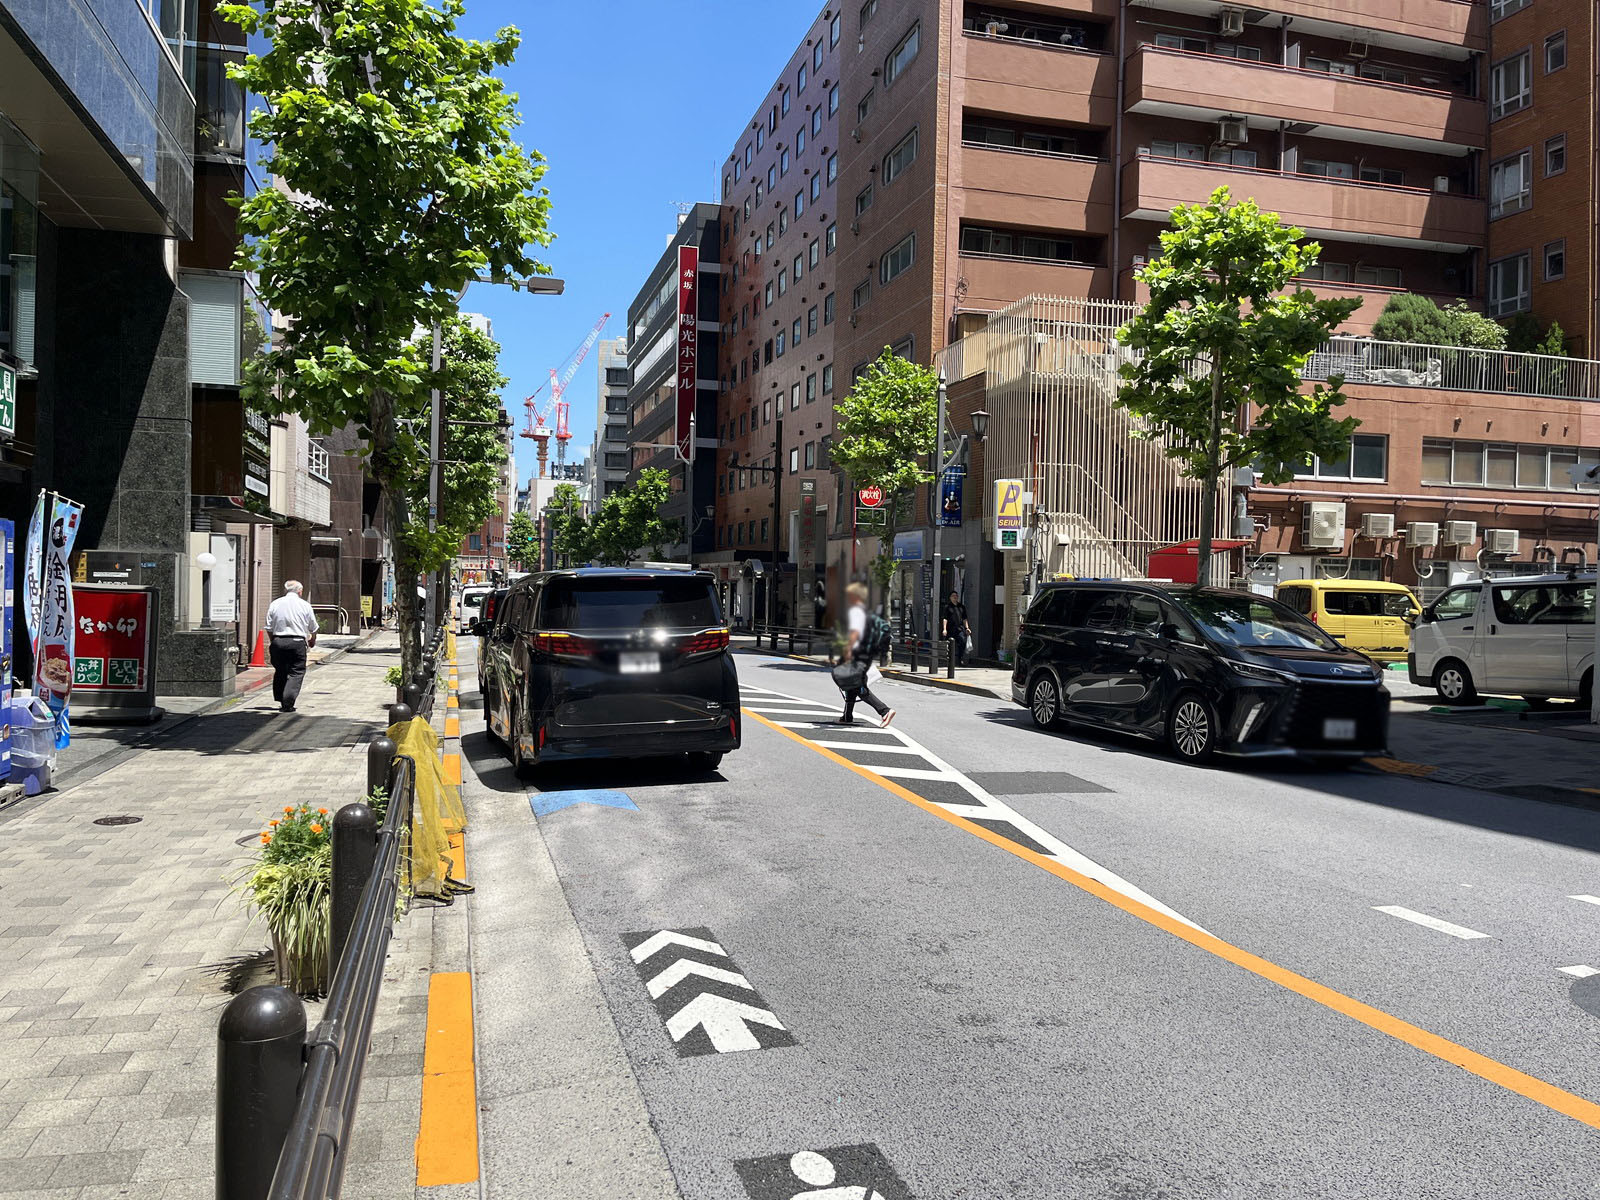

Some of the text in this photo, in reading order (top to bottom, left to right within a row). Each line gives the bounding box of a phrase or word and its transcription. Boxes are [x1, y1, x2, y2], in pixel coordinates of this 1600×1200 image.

[683, 268, 694, 290] 赤坂
[679, 313, 695, 390] 陽光ホテル
[861, 489, 880, 500] 消火栓
[1000, 484, 1021, 513] P
[79, 615, 138, 638] なか卯
